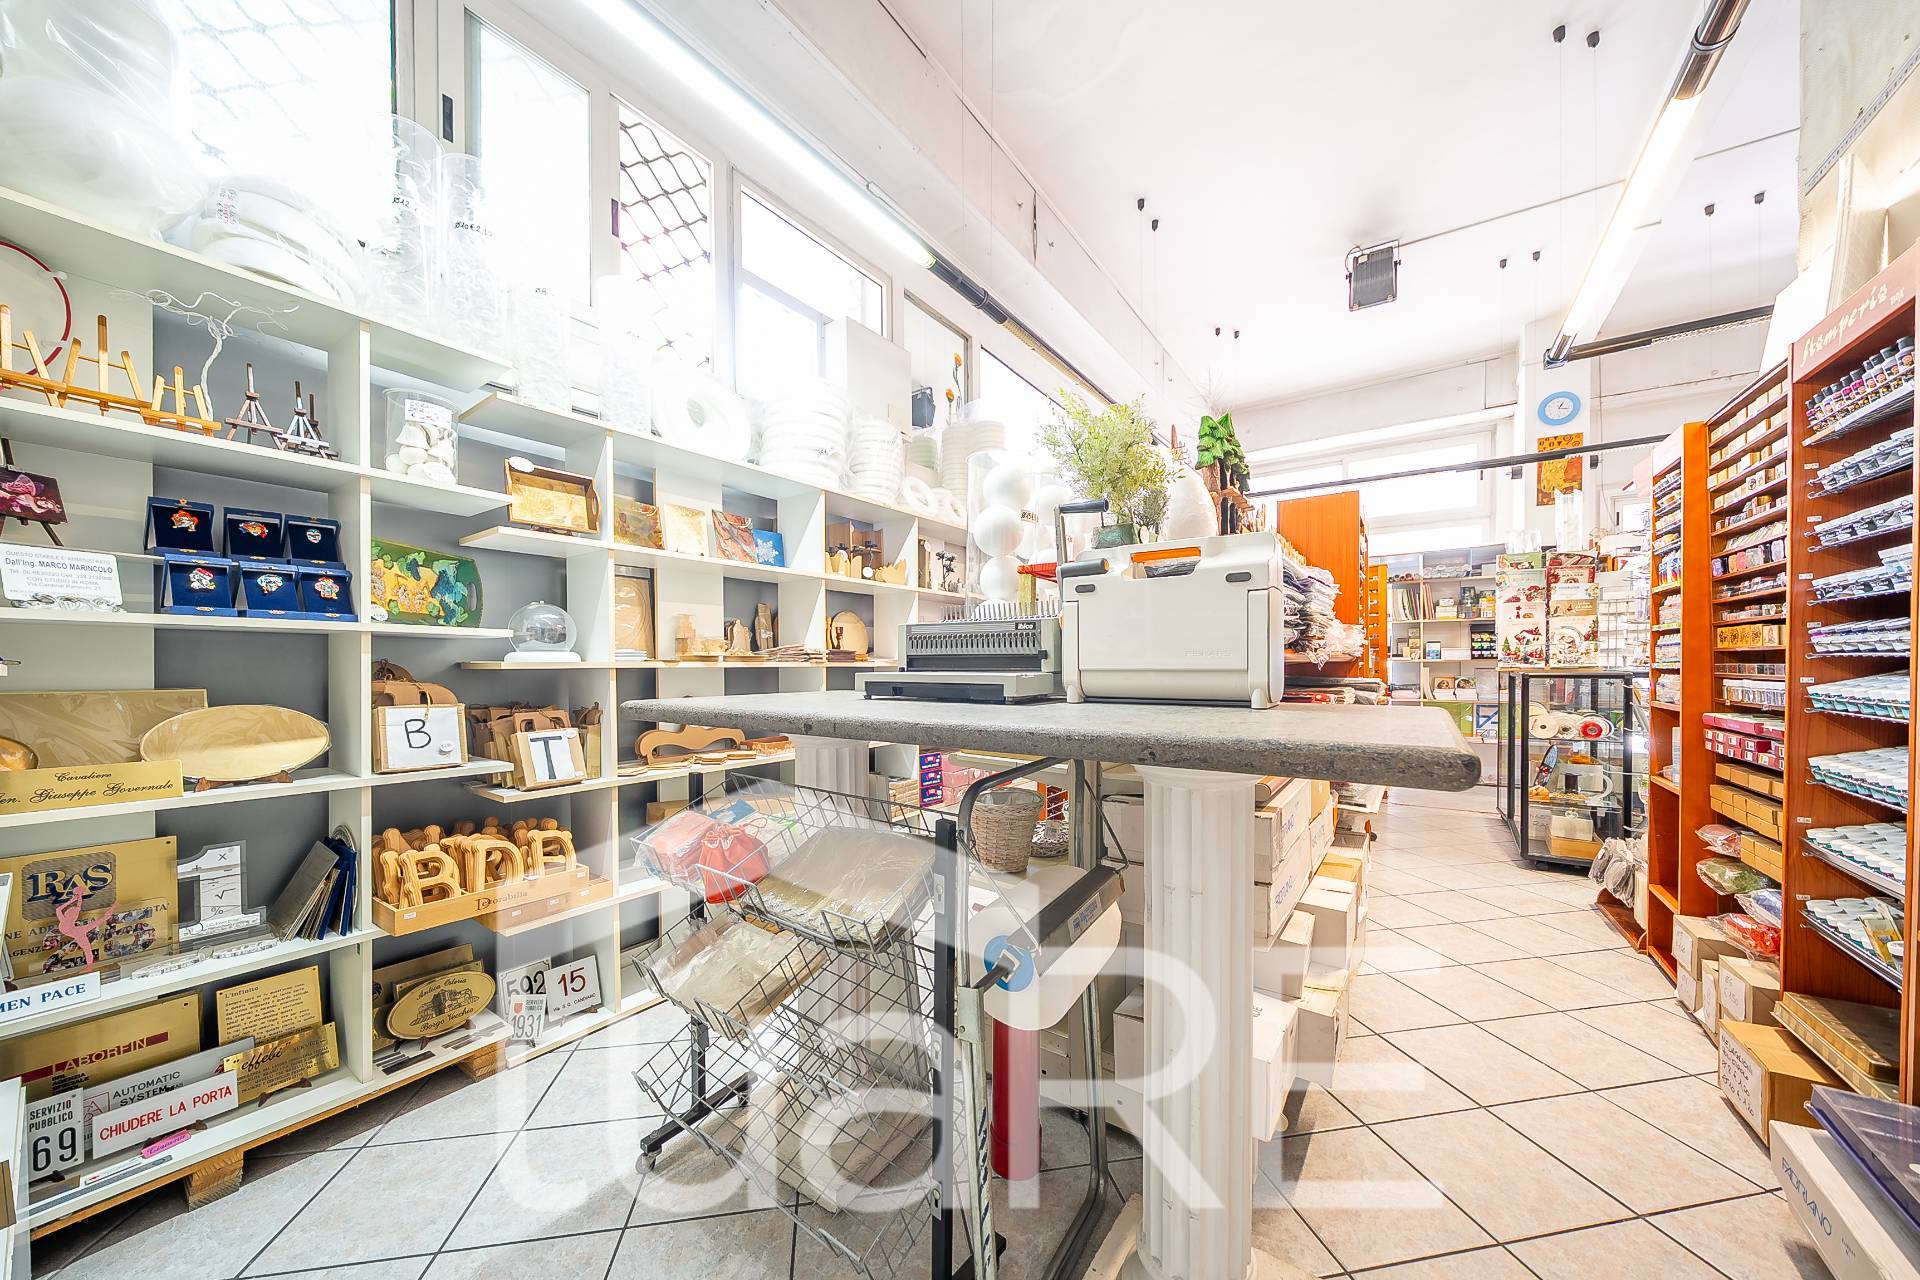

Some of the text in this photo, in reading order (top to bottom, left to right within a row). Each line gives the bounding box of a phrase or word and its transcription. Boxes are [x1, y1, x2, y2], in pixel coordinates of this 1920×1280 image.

[38, 560, 68, 570] MARCO
[69, 562, 113, 574] MARINCOLO
[404, 718, 432, 749] B
[529, 735, 562, 780] T
[29, 787, 97, 804] Giuseppe
[102, 779, 174, 797] Governale
[54, 771, 112, 783] Cavaliere
[26, 862, 113, 903] RAS
[41, 983, 87, 1003] PACE
[558, 967, 588, 997] 15
[511, 1014, 543, 1039] 1931
[52, 1037, 148, 1077] LABORFIN
[112, 1071, 181, 1100] AUTOMATIC
[120, 1085, 168, 1107] SYSTEM
[29, 1099, 72, 1120] SERVIZIO
[29, 1111, 73, 1133] PUBBLICO
[99, 1108, 163, 1141] CHIUDERE
[169, 1099, 187, 1117] LA
[192, 1085, 233, 1109] PORTA
[32, 1126, 78, 1172] 69
[1781, 1156, 1832, 1237] FABRIANO
